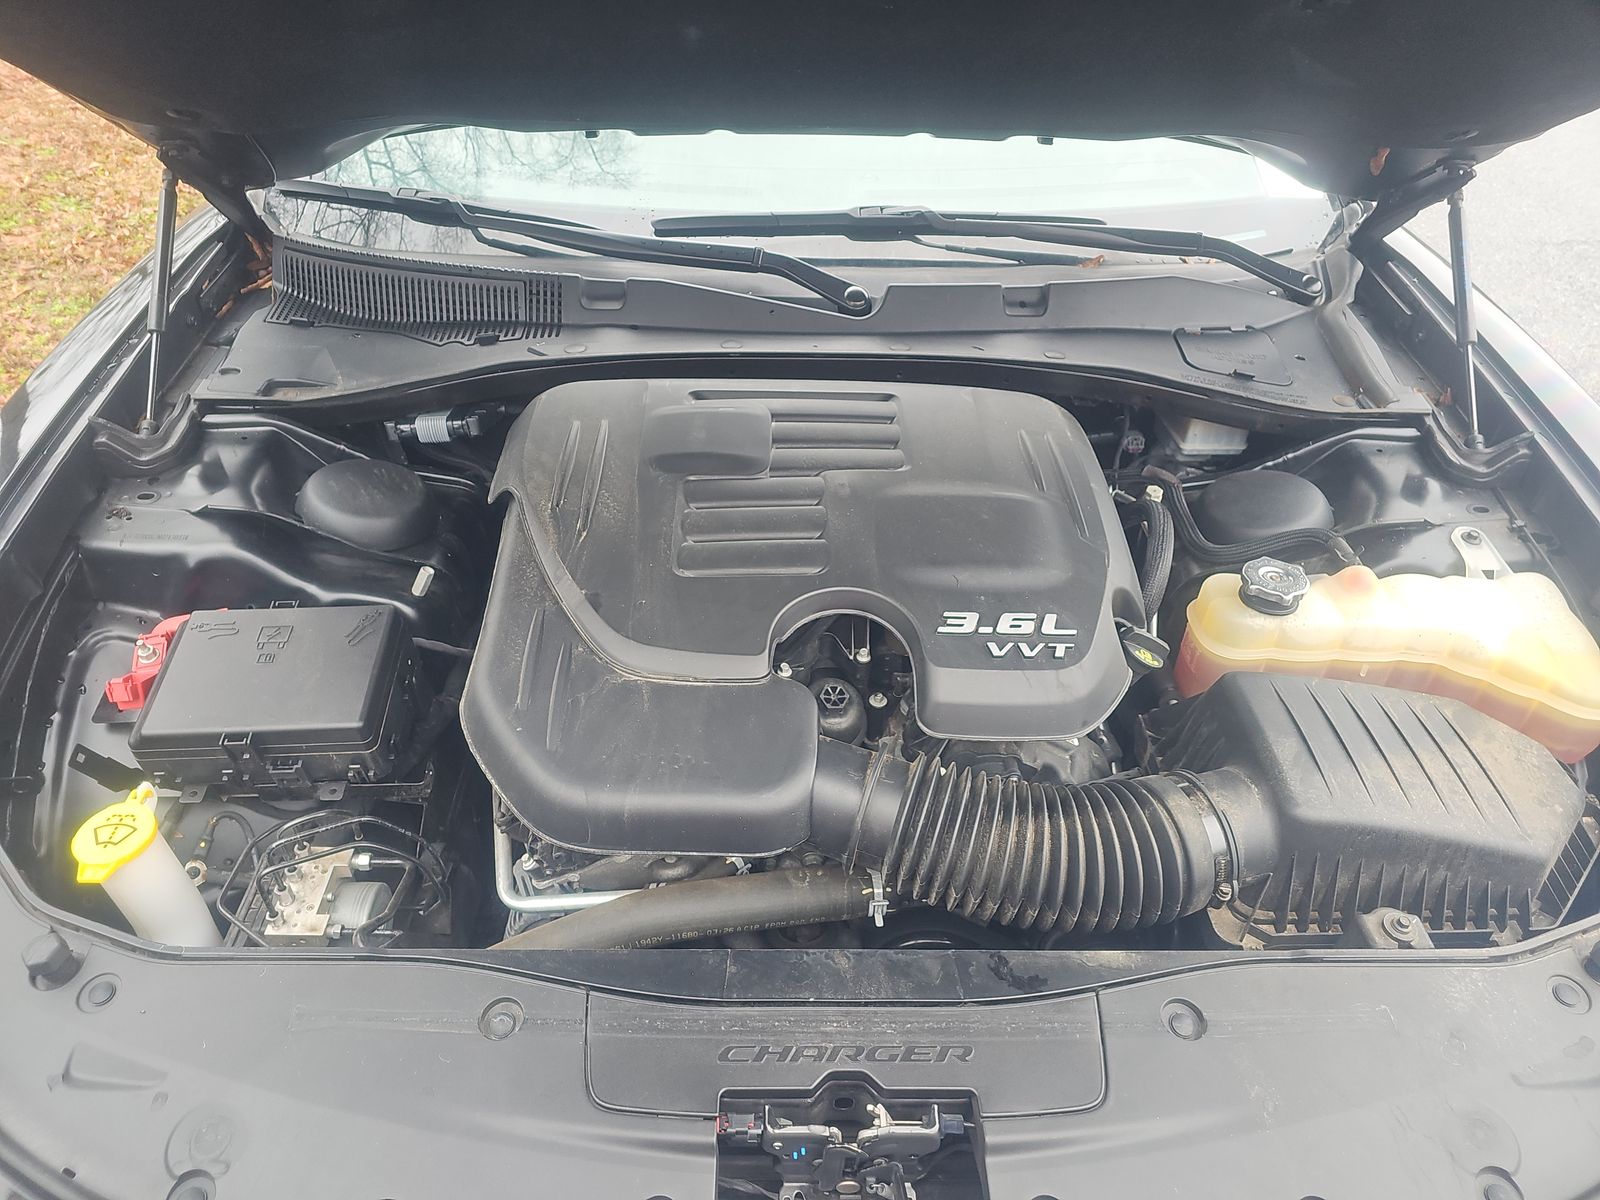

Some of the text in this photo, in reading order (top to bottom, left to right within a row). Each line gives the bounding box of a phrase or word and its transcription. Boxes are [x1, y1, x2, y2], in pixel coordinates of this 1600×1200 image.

[936, 611, 1078, 636] 3.6L
[985, 641, 1075, 659] VVT
[717, 1044, 976, 1065] CHARGER
